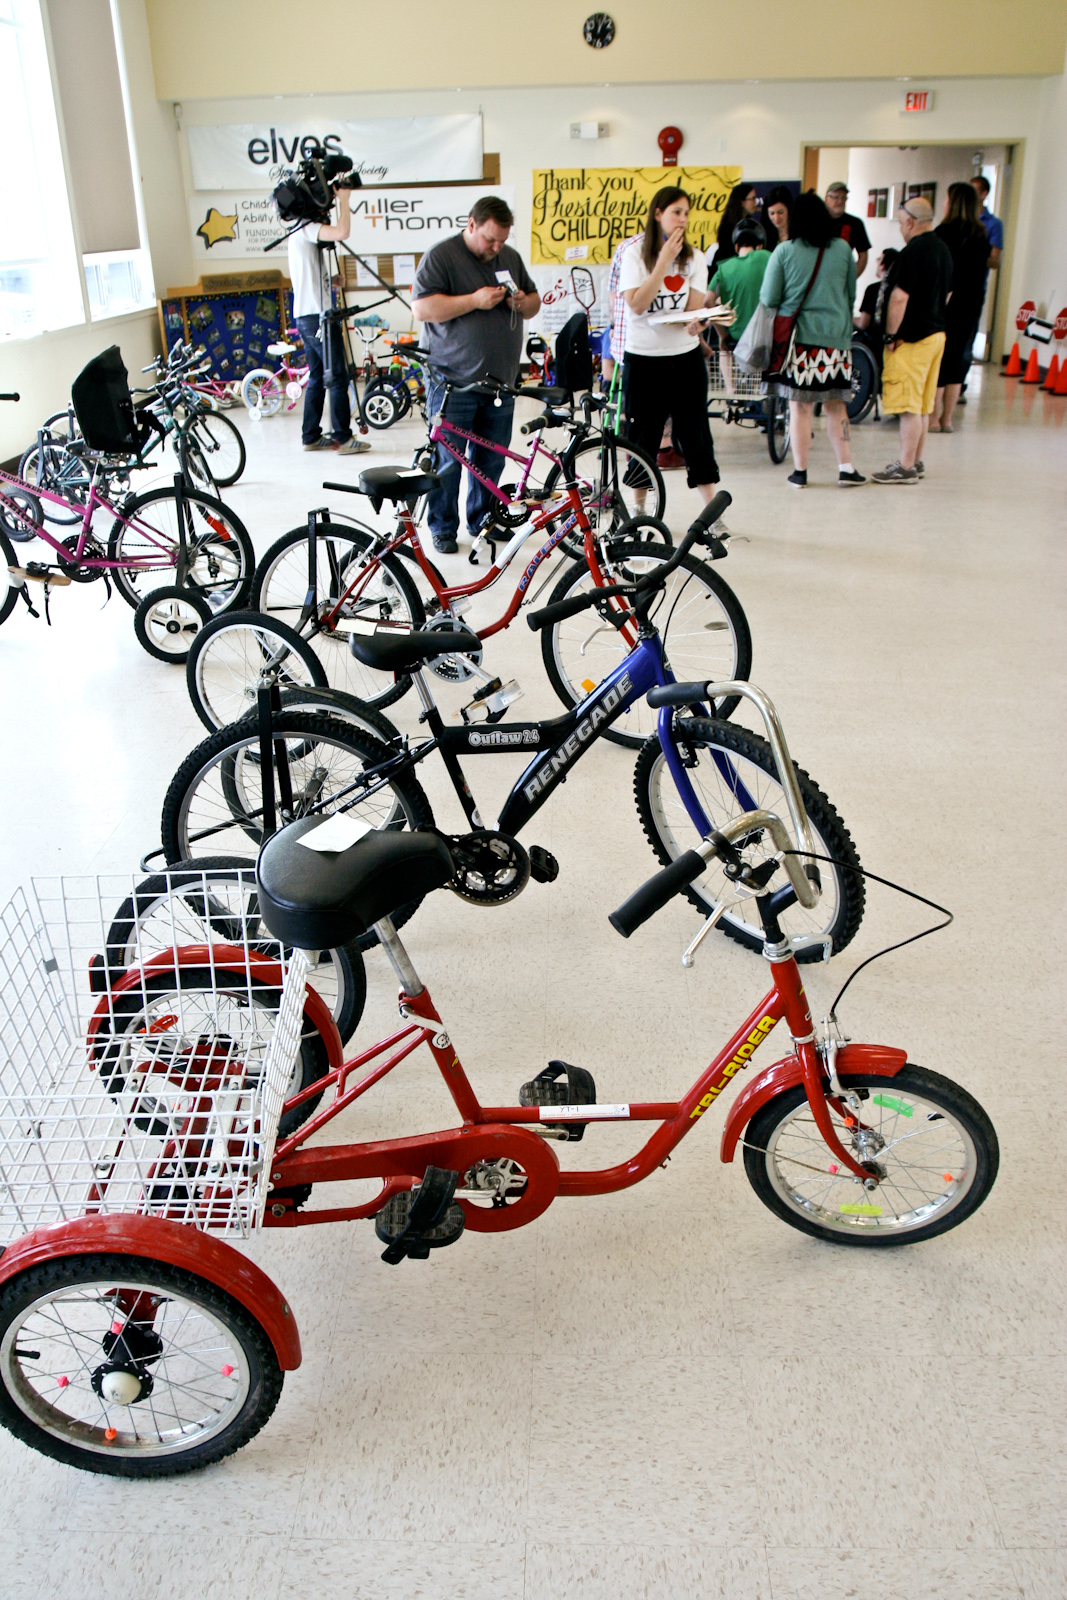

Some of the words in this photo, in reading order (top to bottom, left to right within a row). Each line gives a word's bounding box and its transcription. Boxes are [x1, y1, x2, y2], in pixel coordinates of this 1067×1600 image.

[905, 91, 929, 111] EXIT
[248, 127, 344, 165] elves
[539, 169, 592, 191] Thank
[598, 177, 634, 198] you
[348, 198, 423, 214] Miller
[533, 189, 648, 226] President's
[243, 213, 273, 223] Ability
[246, 229, 282, 237] FUNDING
[648, 293, 686, 313] NY
[0, 471, 43, 493] NDOWNER
[518, 513, 577, 592] RALEIGH
[469, 731, 522, 747] Outlaw
[523, 671, 634, 804] RENEGADE
[689, 1015, 777, 1119] TRI-RIDER
